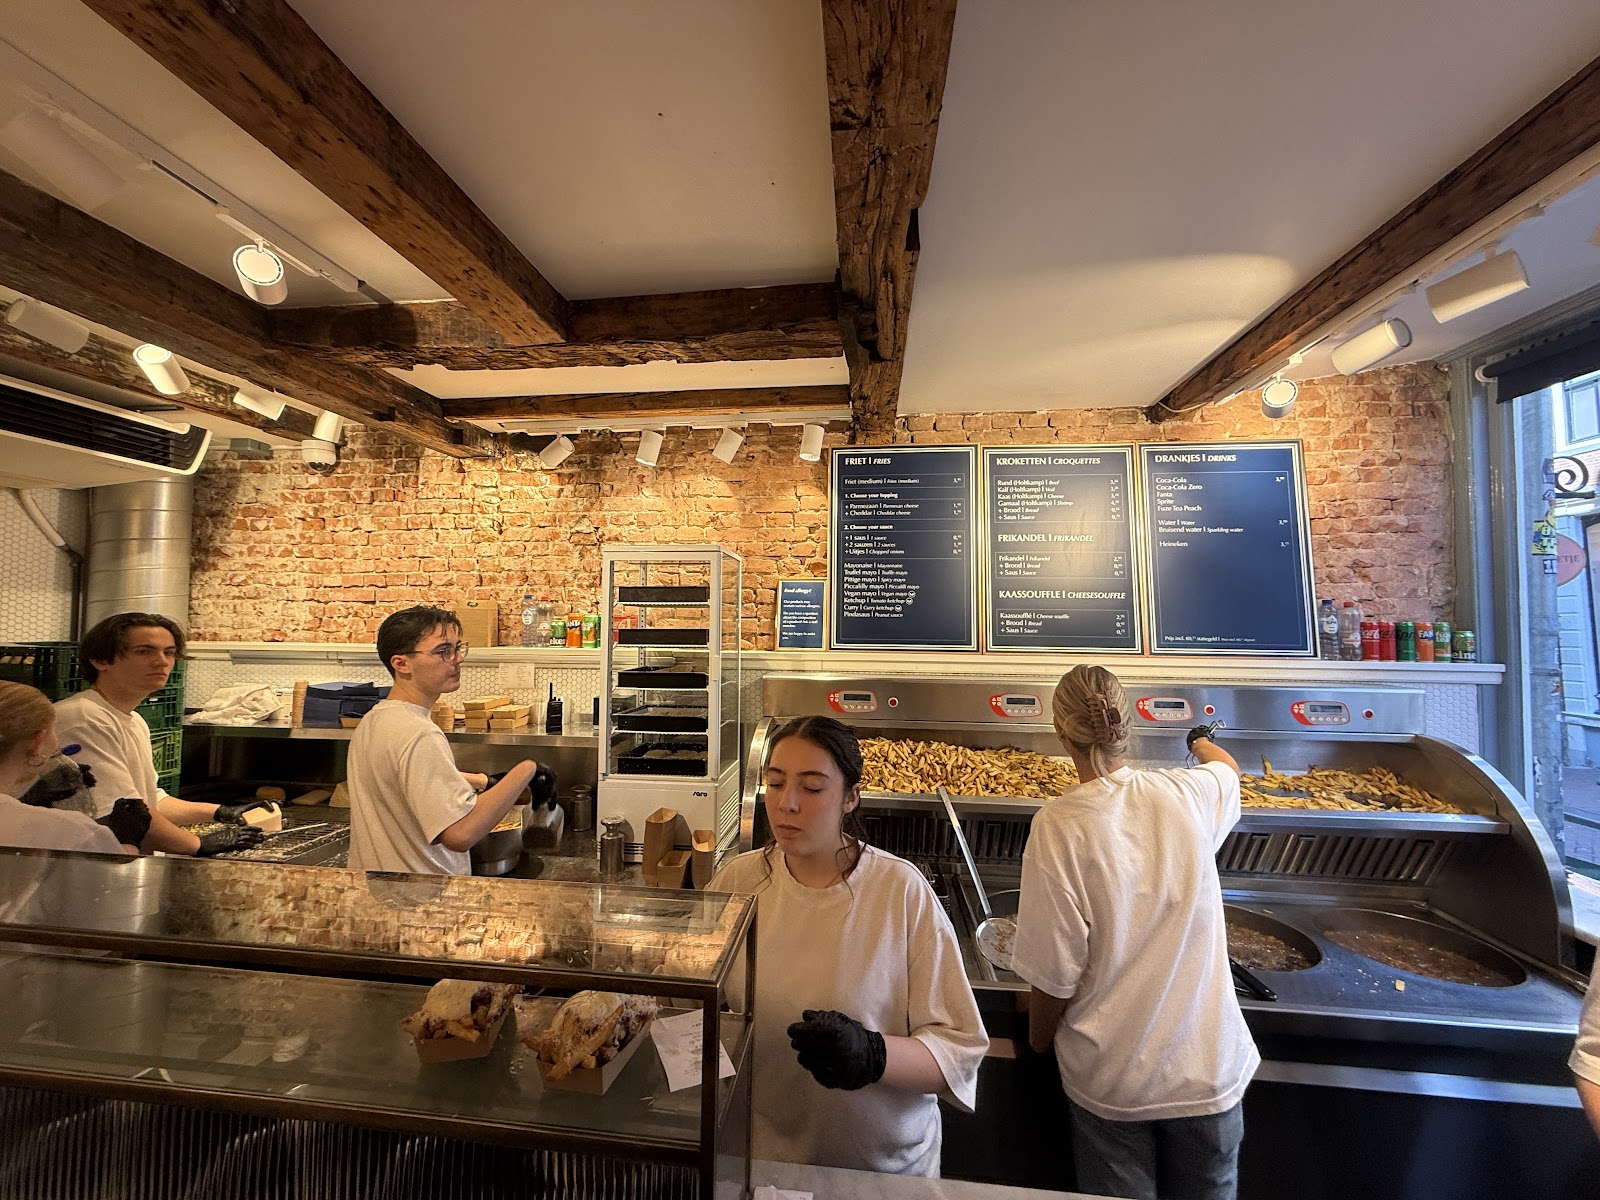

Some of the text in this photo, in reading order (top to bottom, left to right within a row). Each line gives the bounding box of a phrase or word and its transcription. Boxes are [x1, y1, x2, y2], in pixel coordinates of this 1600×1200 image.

[1053, 457, 1101, 465] CROQUETTES
[1155, 454, 1237, 463] DRANKJES DRINKS
[999, 590, 1060, 598] KAASSOUFFLE
